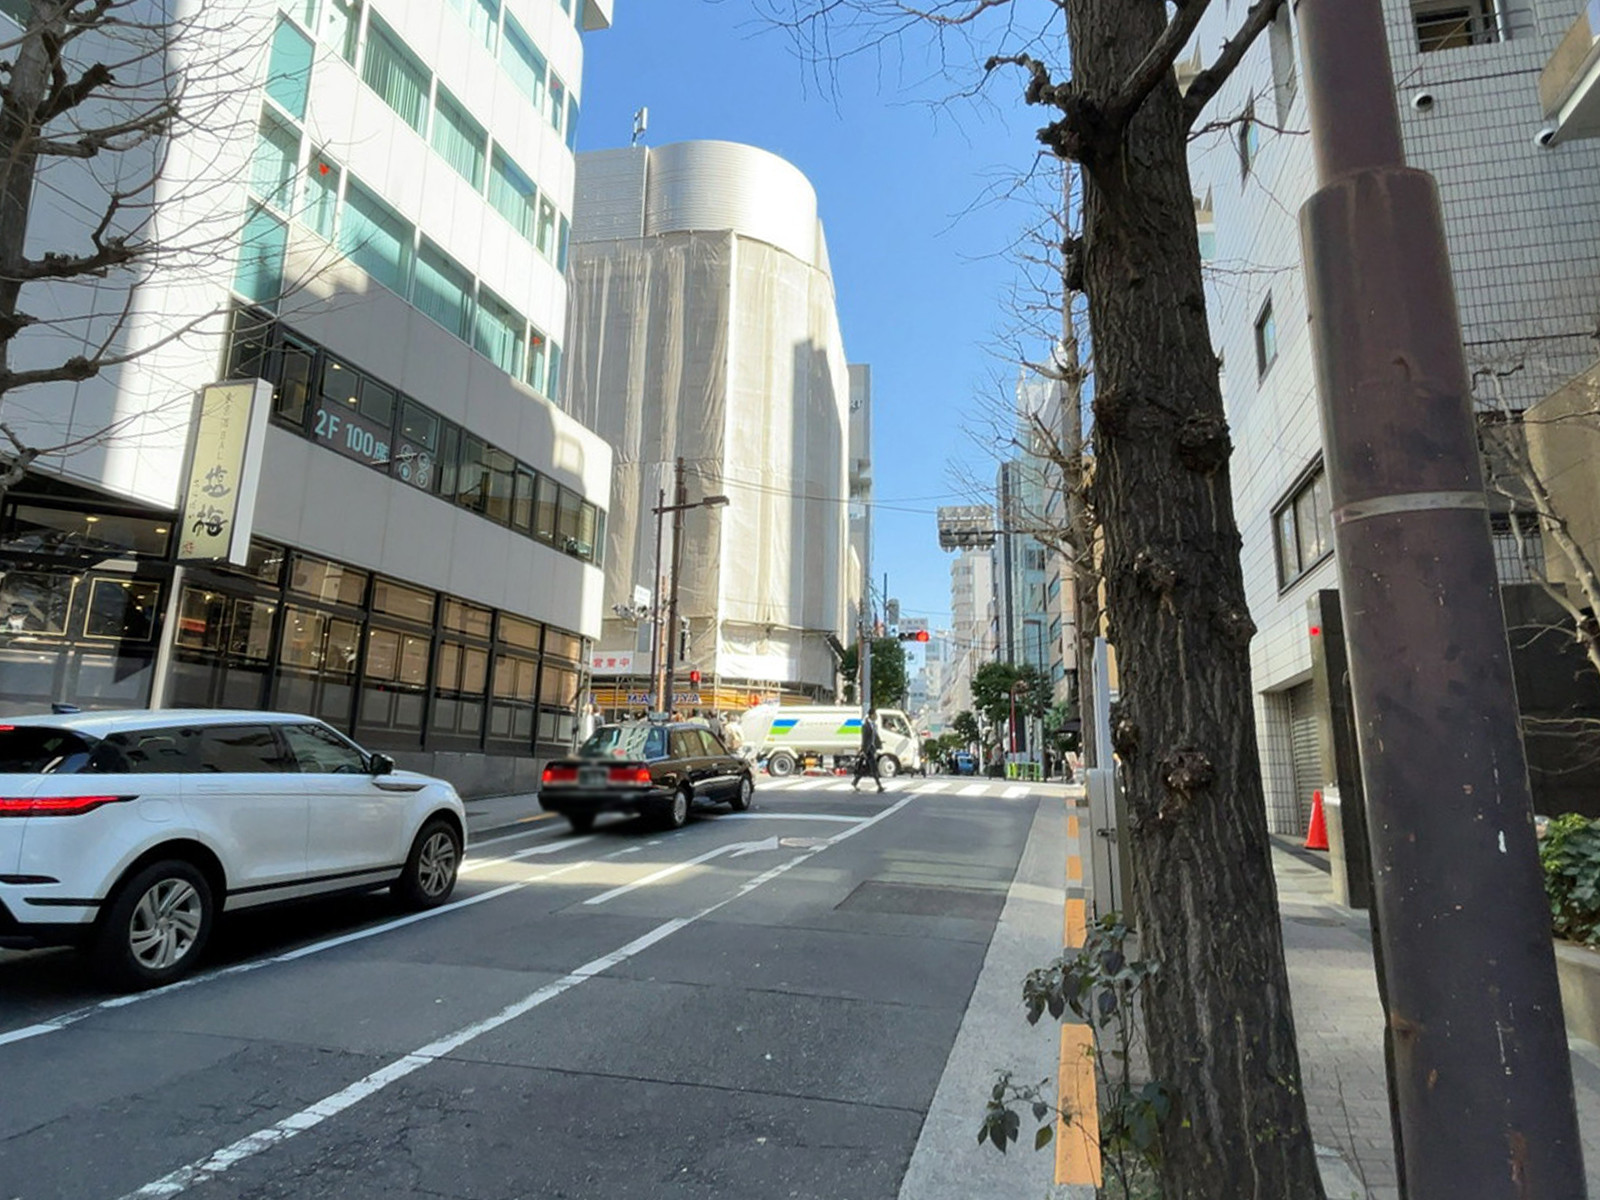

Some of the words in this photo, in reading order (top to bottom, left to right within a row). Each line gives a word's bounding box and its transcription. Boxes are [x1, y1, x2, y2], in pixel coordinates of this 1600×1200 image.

[314, 409, 341, 440] 2F
[593, 657, 630, 668] 営業中
[627, 692, 702, 704] MAUYA
